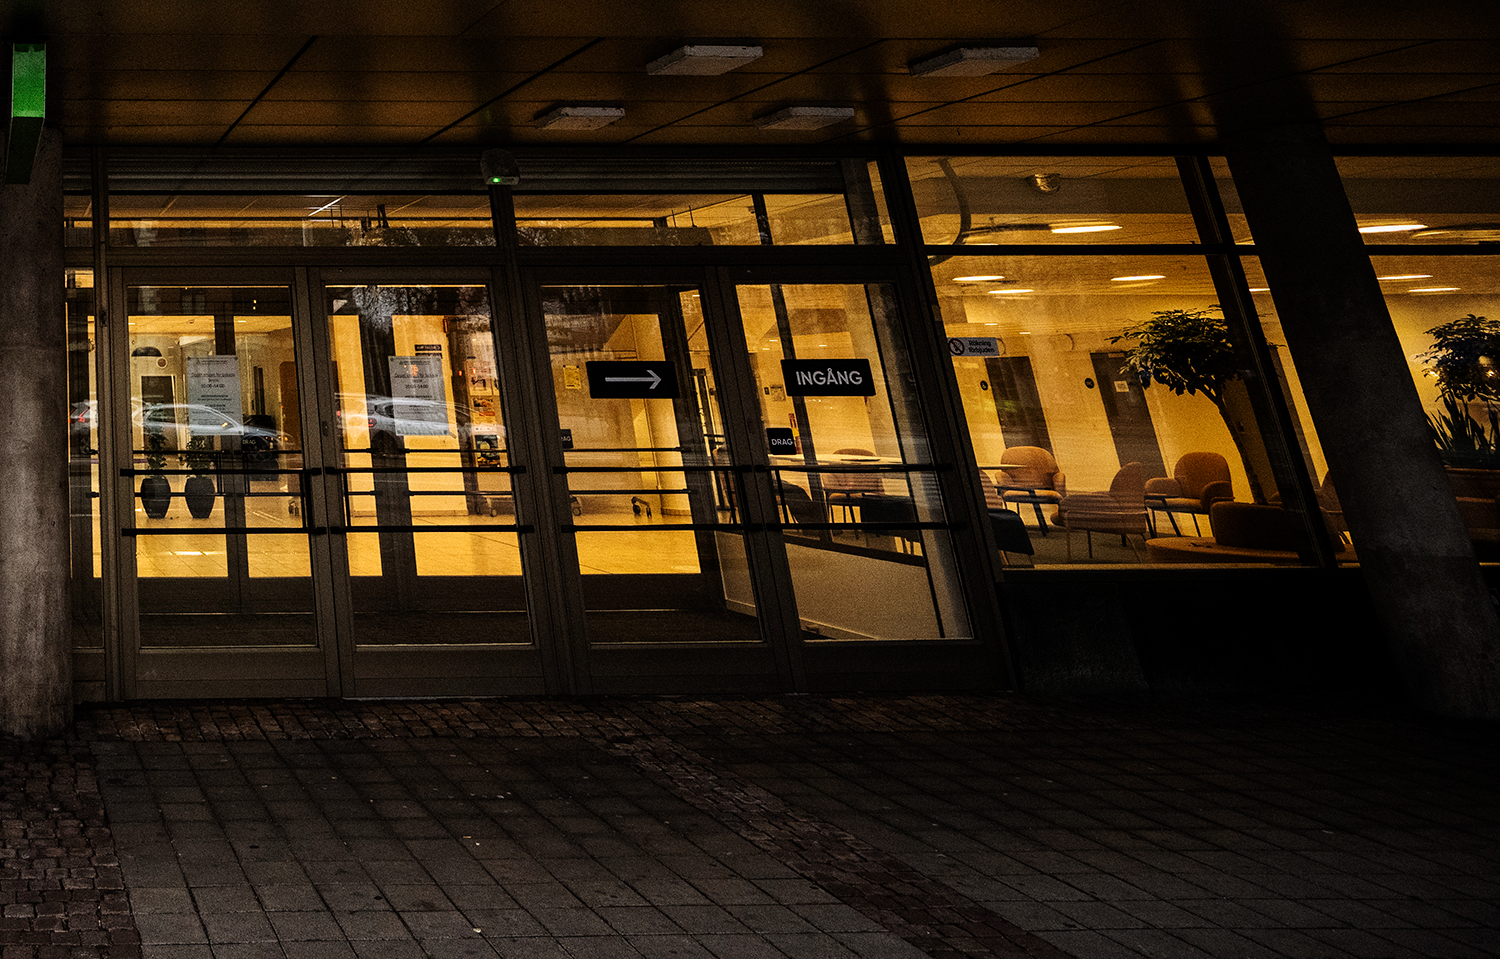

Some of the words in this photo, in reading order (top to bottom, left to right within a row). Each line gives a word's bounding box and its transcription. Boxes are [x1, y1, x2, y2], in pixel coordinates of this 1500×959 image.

[968, 339, 991, 347] Rökning
[968, 346, 995, 354] förbjuden
[795, 367, 863, 385] INGÅNG
[771, 438, 794, 446] DRAG
